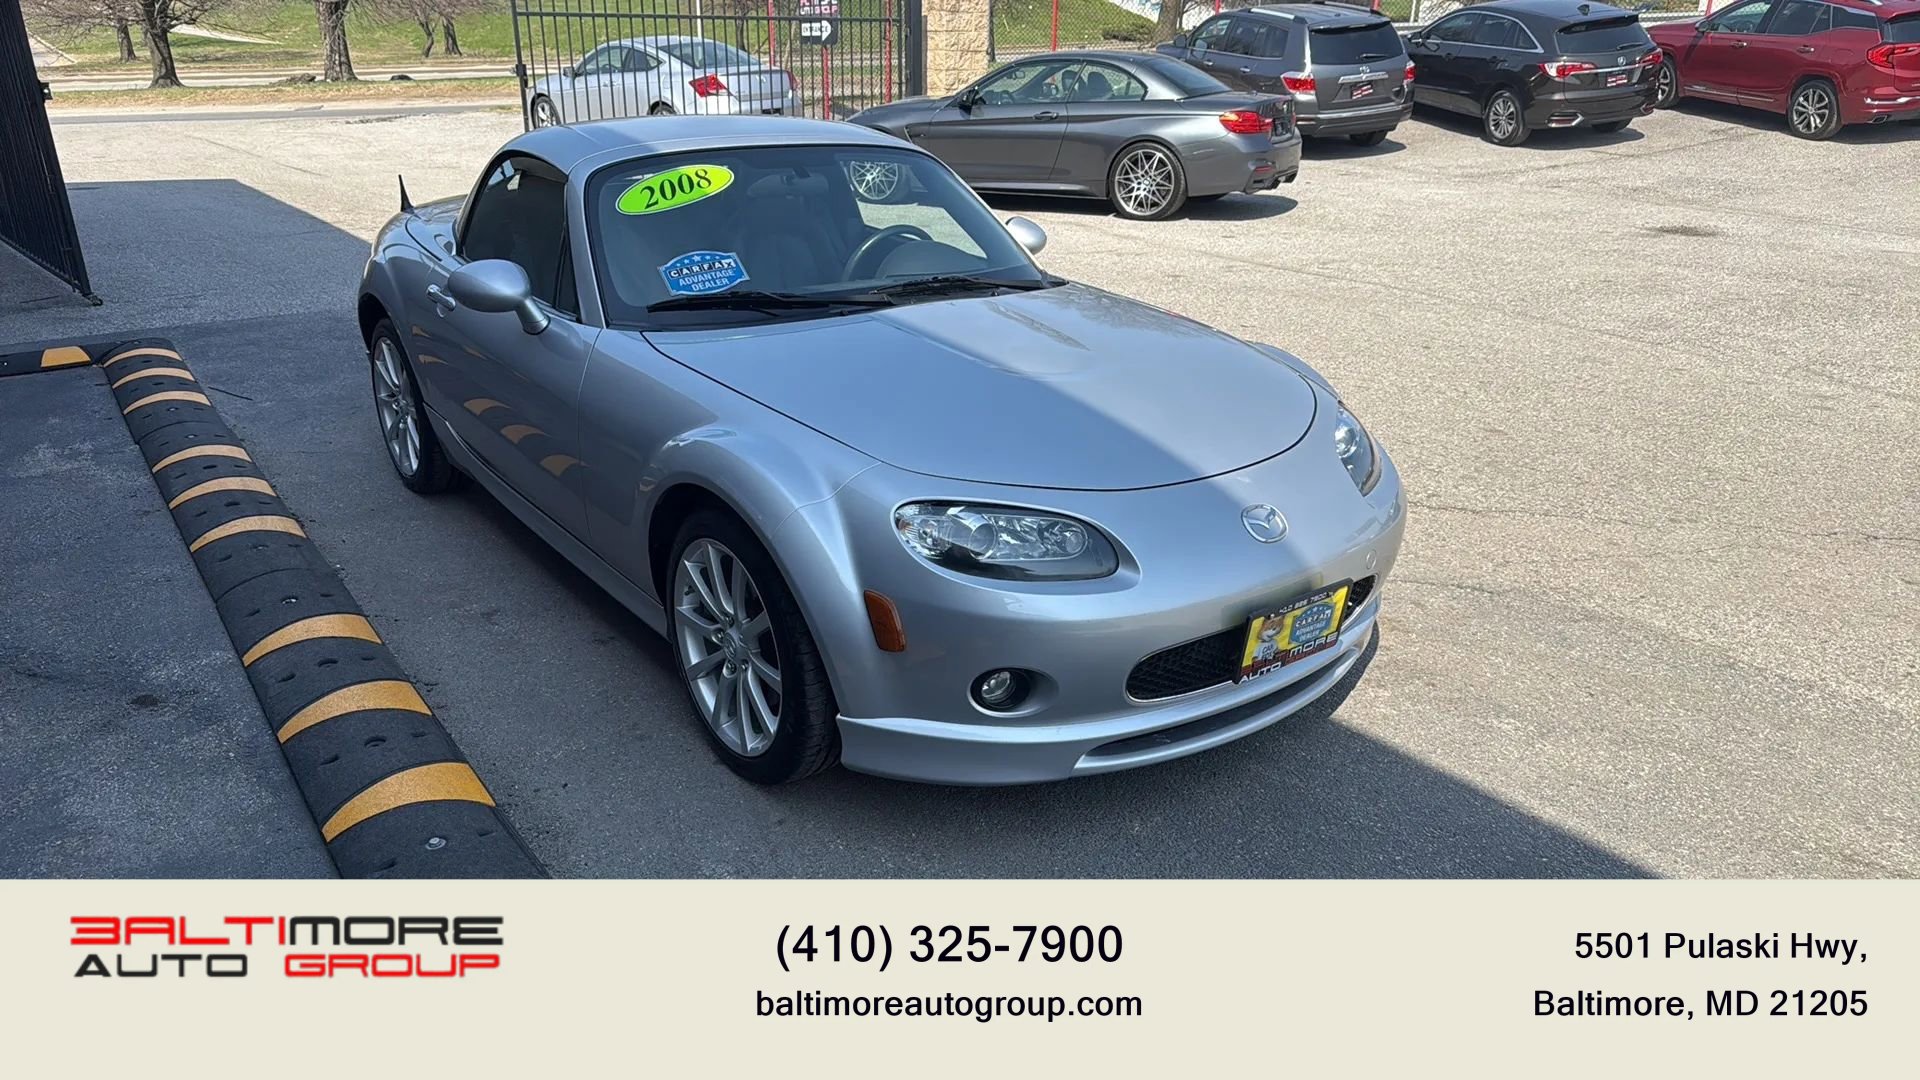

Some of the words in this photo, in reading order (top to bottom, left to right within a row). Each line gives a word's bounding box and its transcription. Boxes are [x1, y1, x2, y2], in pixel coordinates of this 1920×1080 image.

[640, 168, 712, 209] 2008
[668, 258, 737, 280] CARFAX
[679, 269, 734, 287] ADVANTAGE
[692, 278, 730, 291] DEALER
[1239, 661, 1282, 685] AUTO
